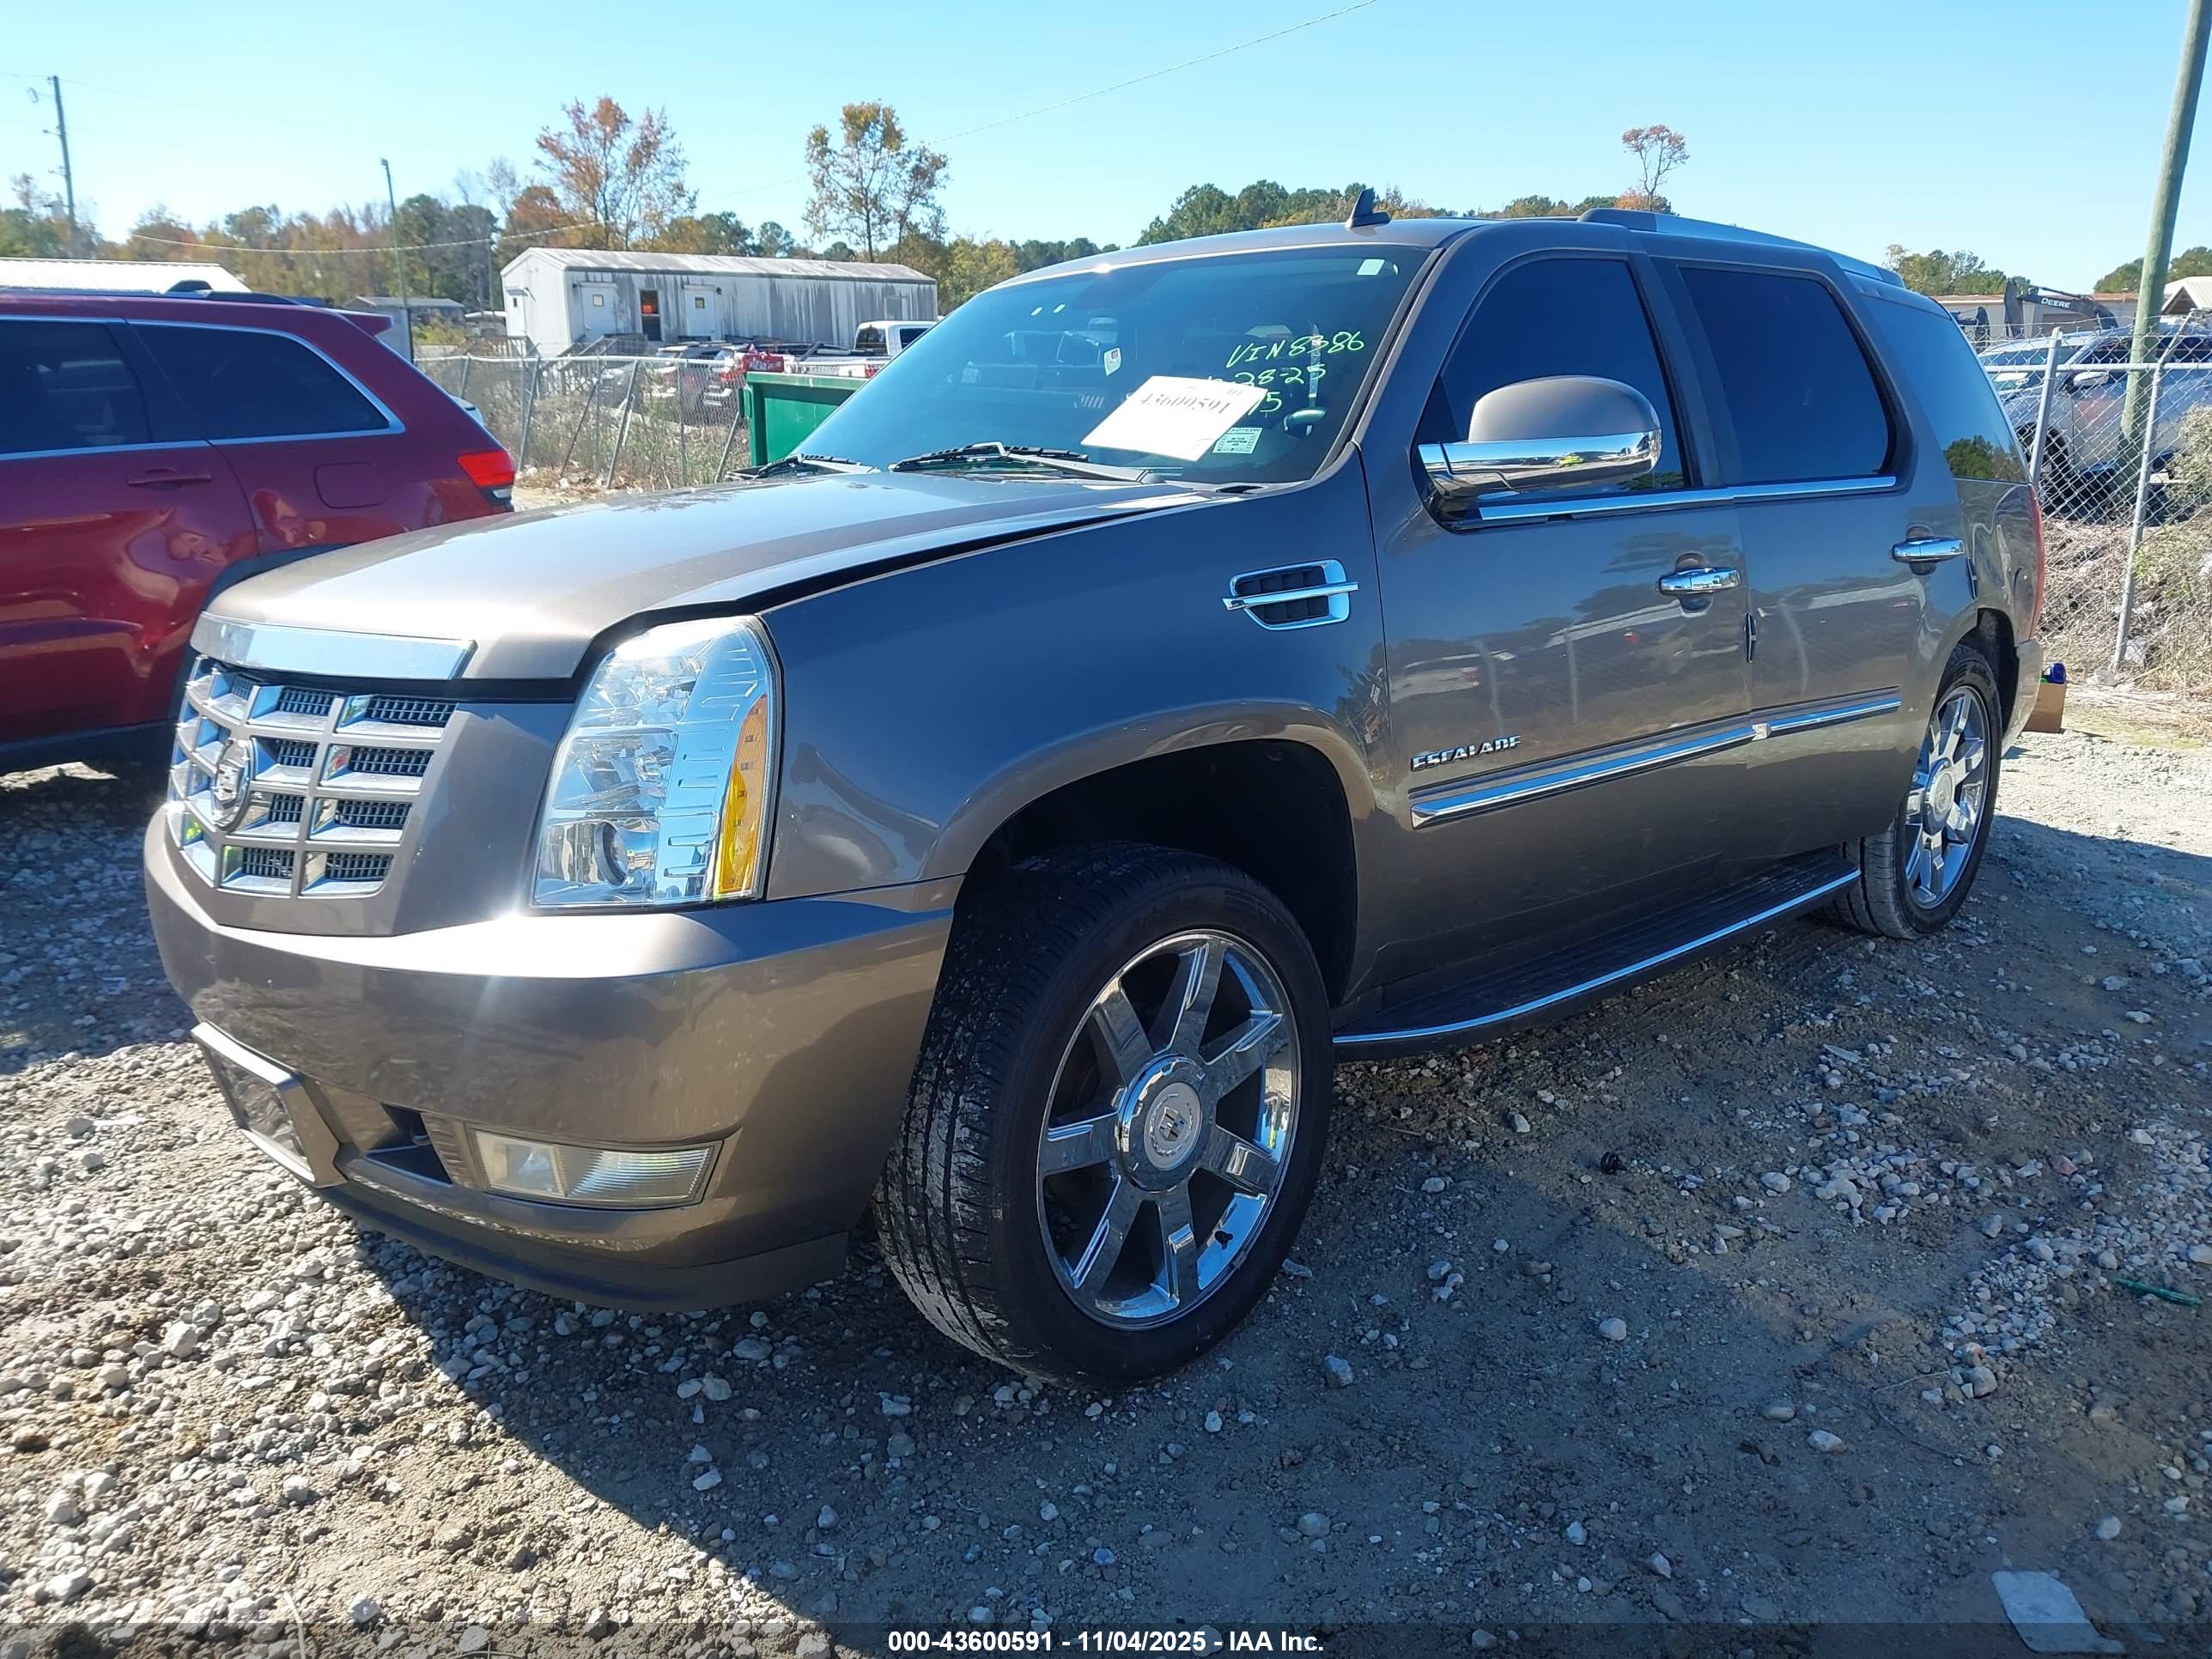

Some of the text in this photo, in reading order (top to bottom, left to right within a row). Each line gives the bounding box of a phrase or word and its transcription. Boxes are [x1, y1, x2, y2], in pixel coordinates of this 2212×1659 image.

[2040, 297, 2071, 308] DEERE
[1225, 331, 1364, 368] VIN 8386
[1410, 735, 1522, 772] ESCALADE
